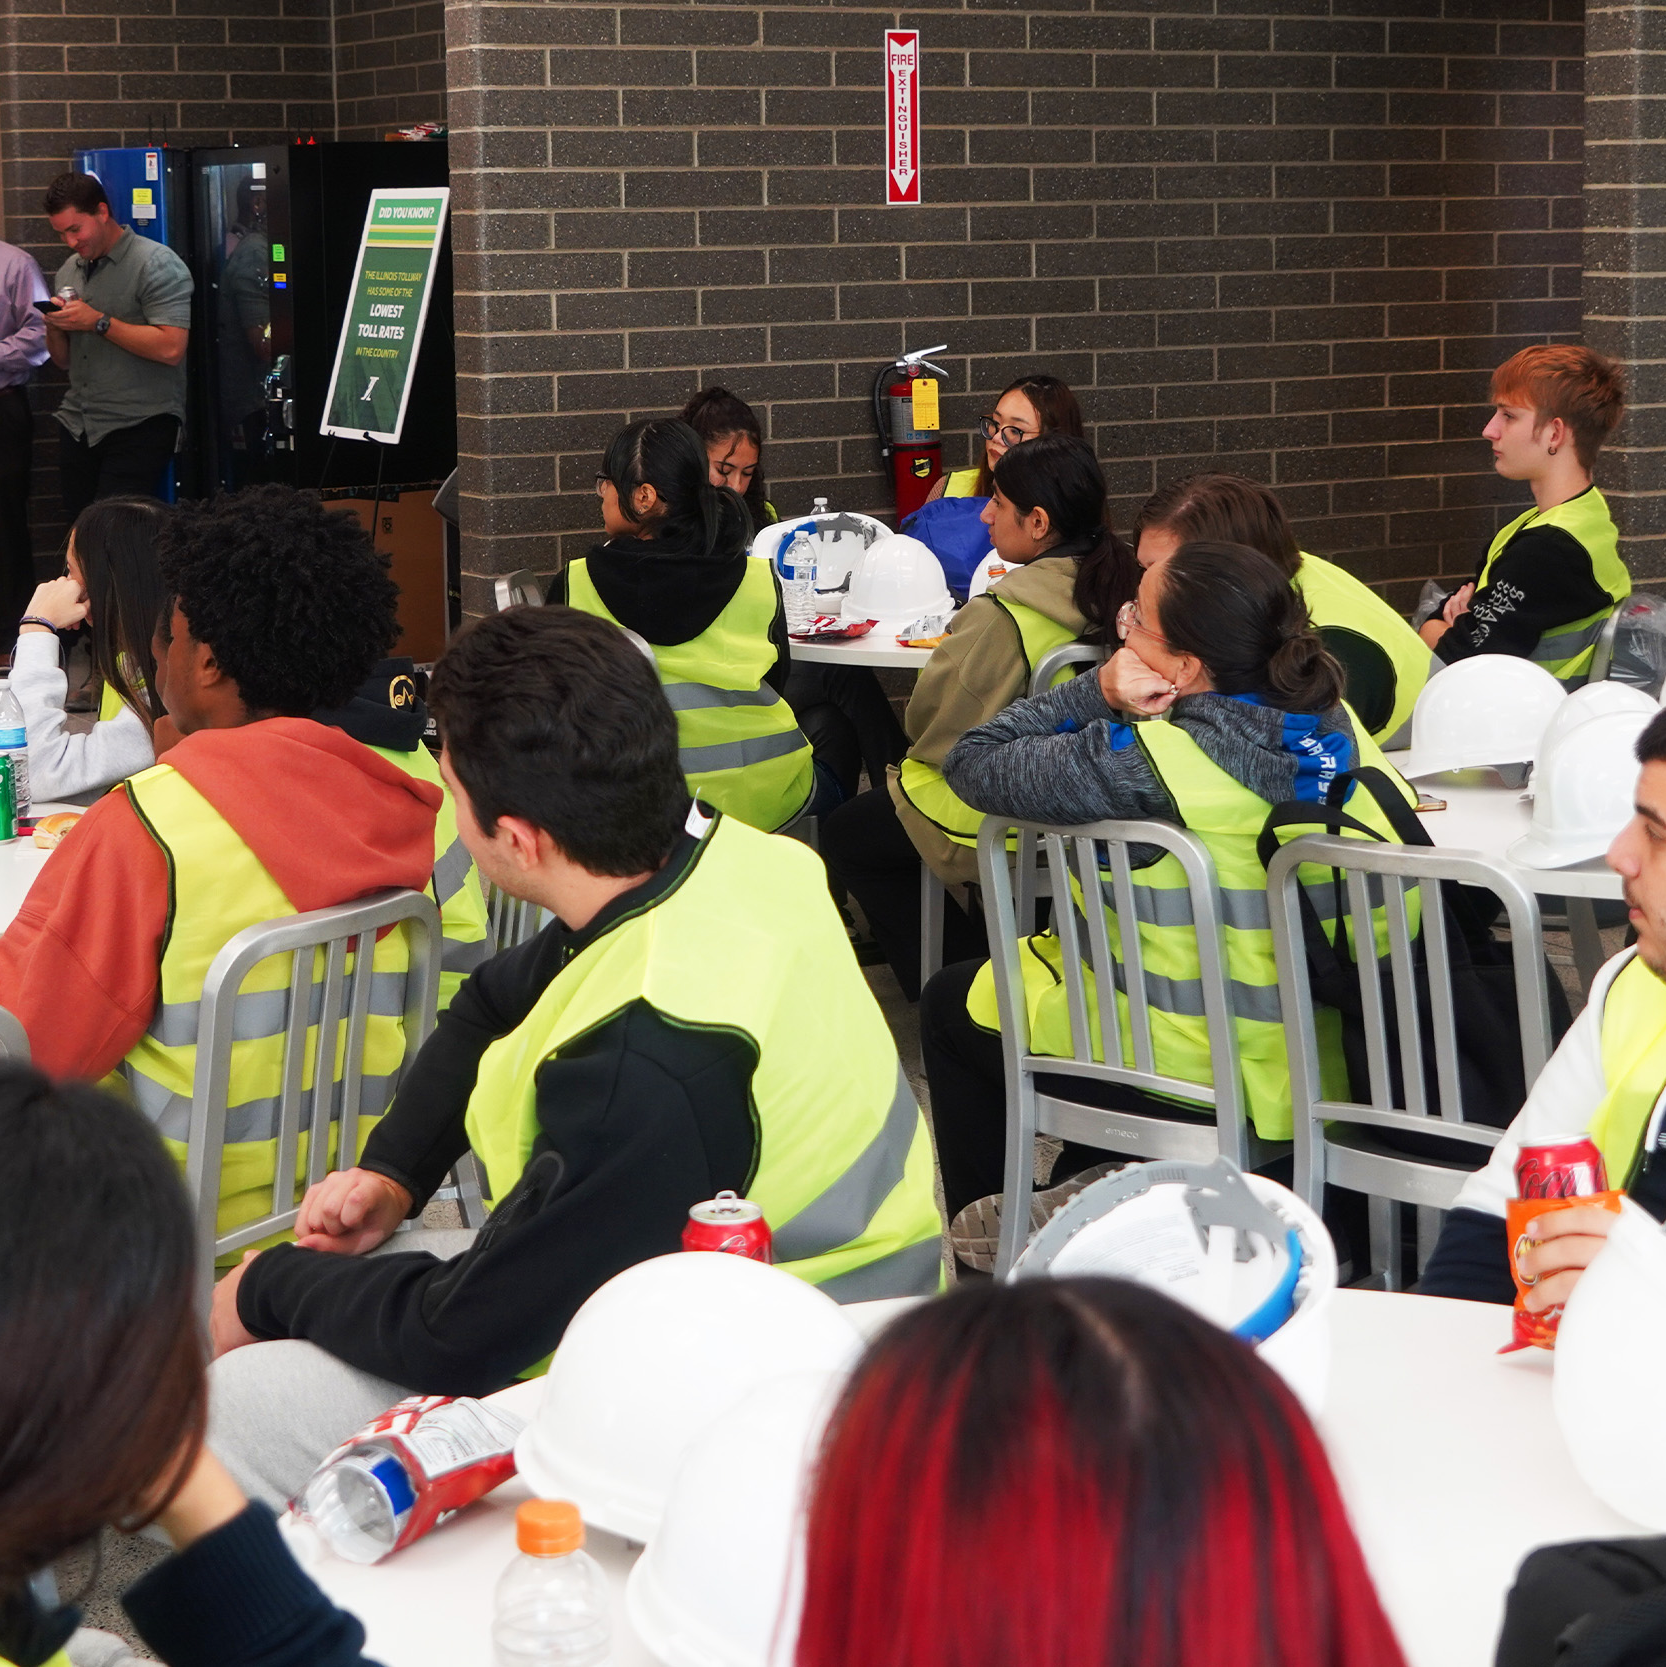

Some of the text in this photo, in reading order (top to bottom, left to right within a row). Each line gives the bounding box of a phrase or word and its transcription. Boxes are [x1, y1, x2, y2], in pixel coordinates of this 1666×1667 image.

[891, 53, 914, 66] FIRE
[897, 69, 908, 176] EXTINGUISHER
[378, 206, 435, 219] DID YOU KNOW?
[364, 270, 423, 283] THE ILLINOIS TOLLWAY
[367, 286, 413, 298] HAS SOME OF THE
[369, 303, 405, 319] LOWEST
[357, 323, 405, 341] TOLL RATES
[355, 346, 400, 360] IN THE COUNTRY
[1105, 1127, 1139, 1140] emeco
